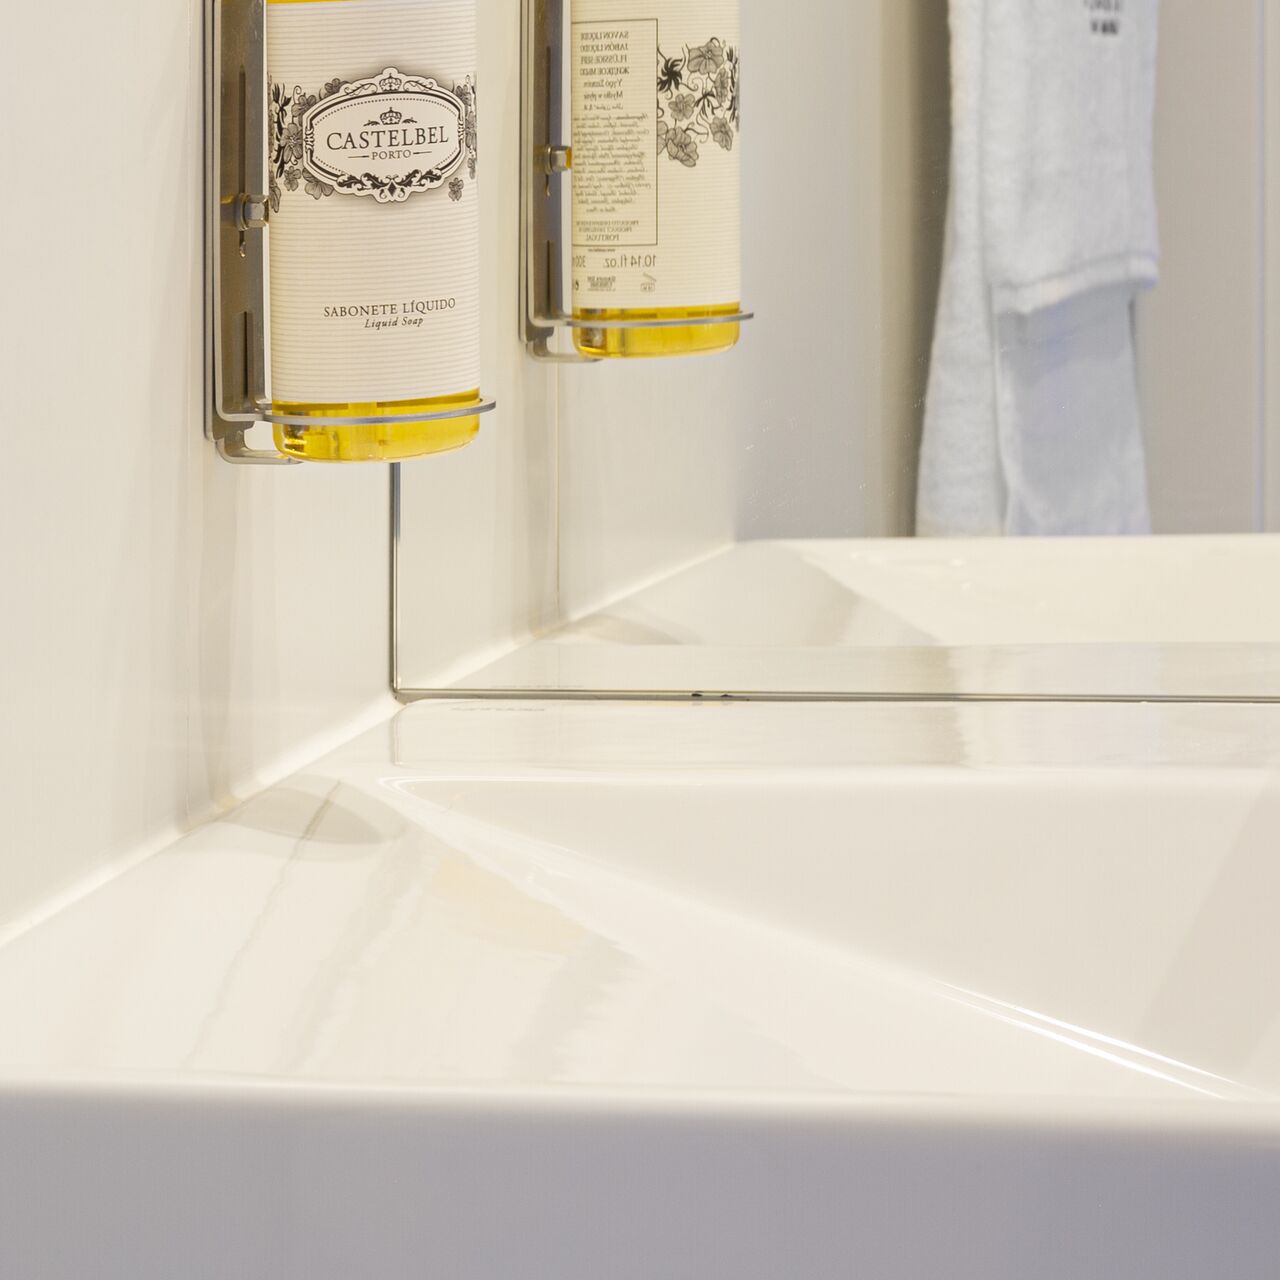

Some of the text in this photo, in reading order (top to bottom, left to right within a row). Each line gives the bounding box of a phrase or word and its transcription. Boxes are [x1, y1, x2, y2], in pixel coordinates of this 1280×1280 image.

[326, 125, 449, 150] CASTELBEL
[371, 149, 412, 160] PORTO
[323, 297, 456, 317] SABONETE LÍQUIDO
[364, 316, 424, 330] Liquid Soap
